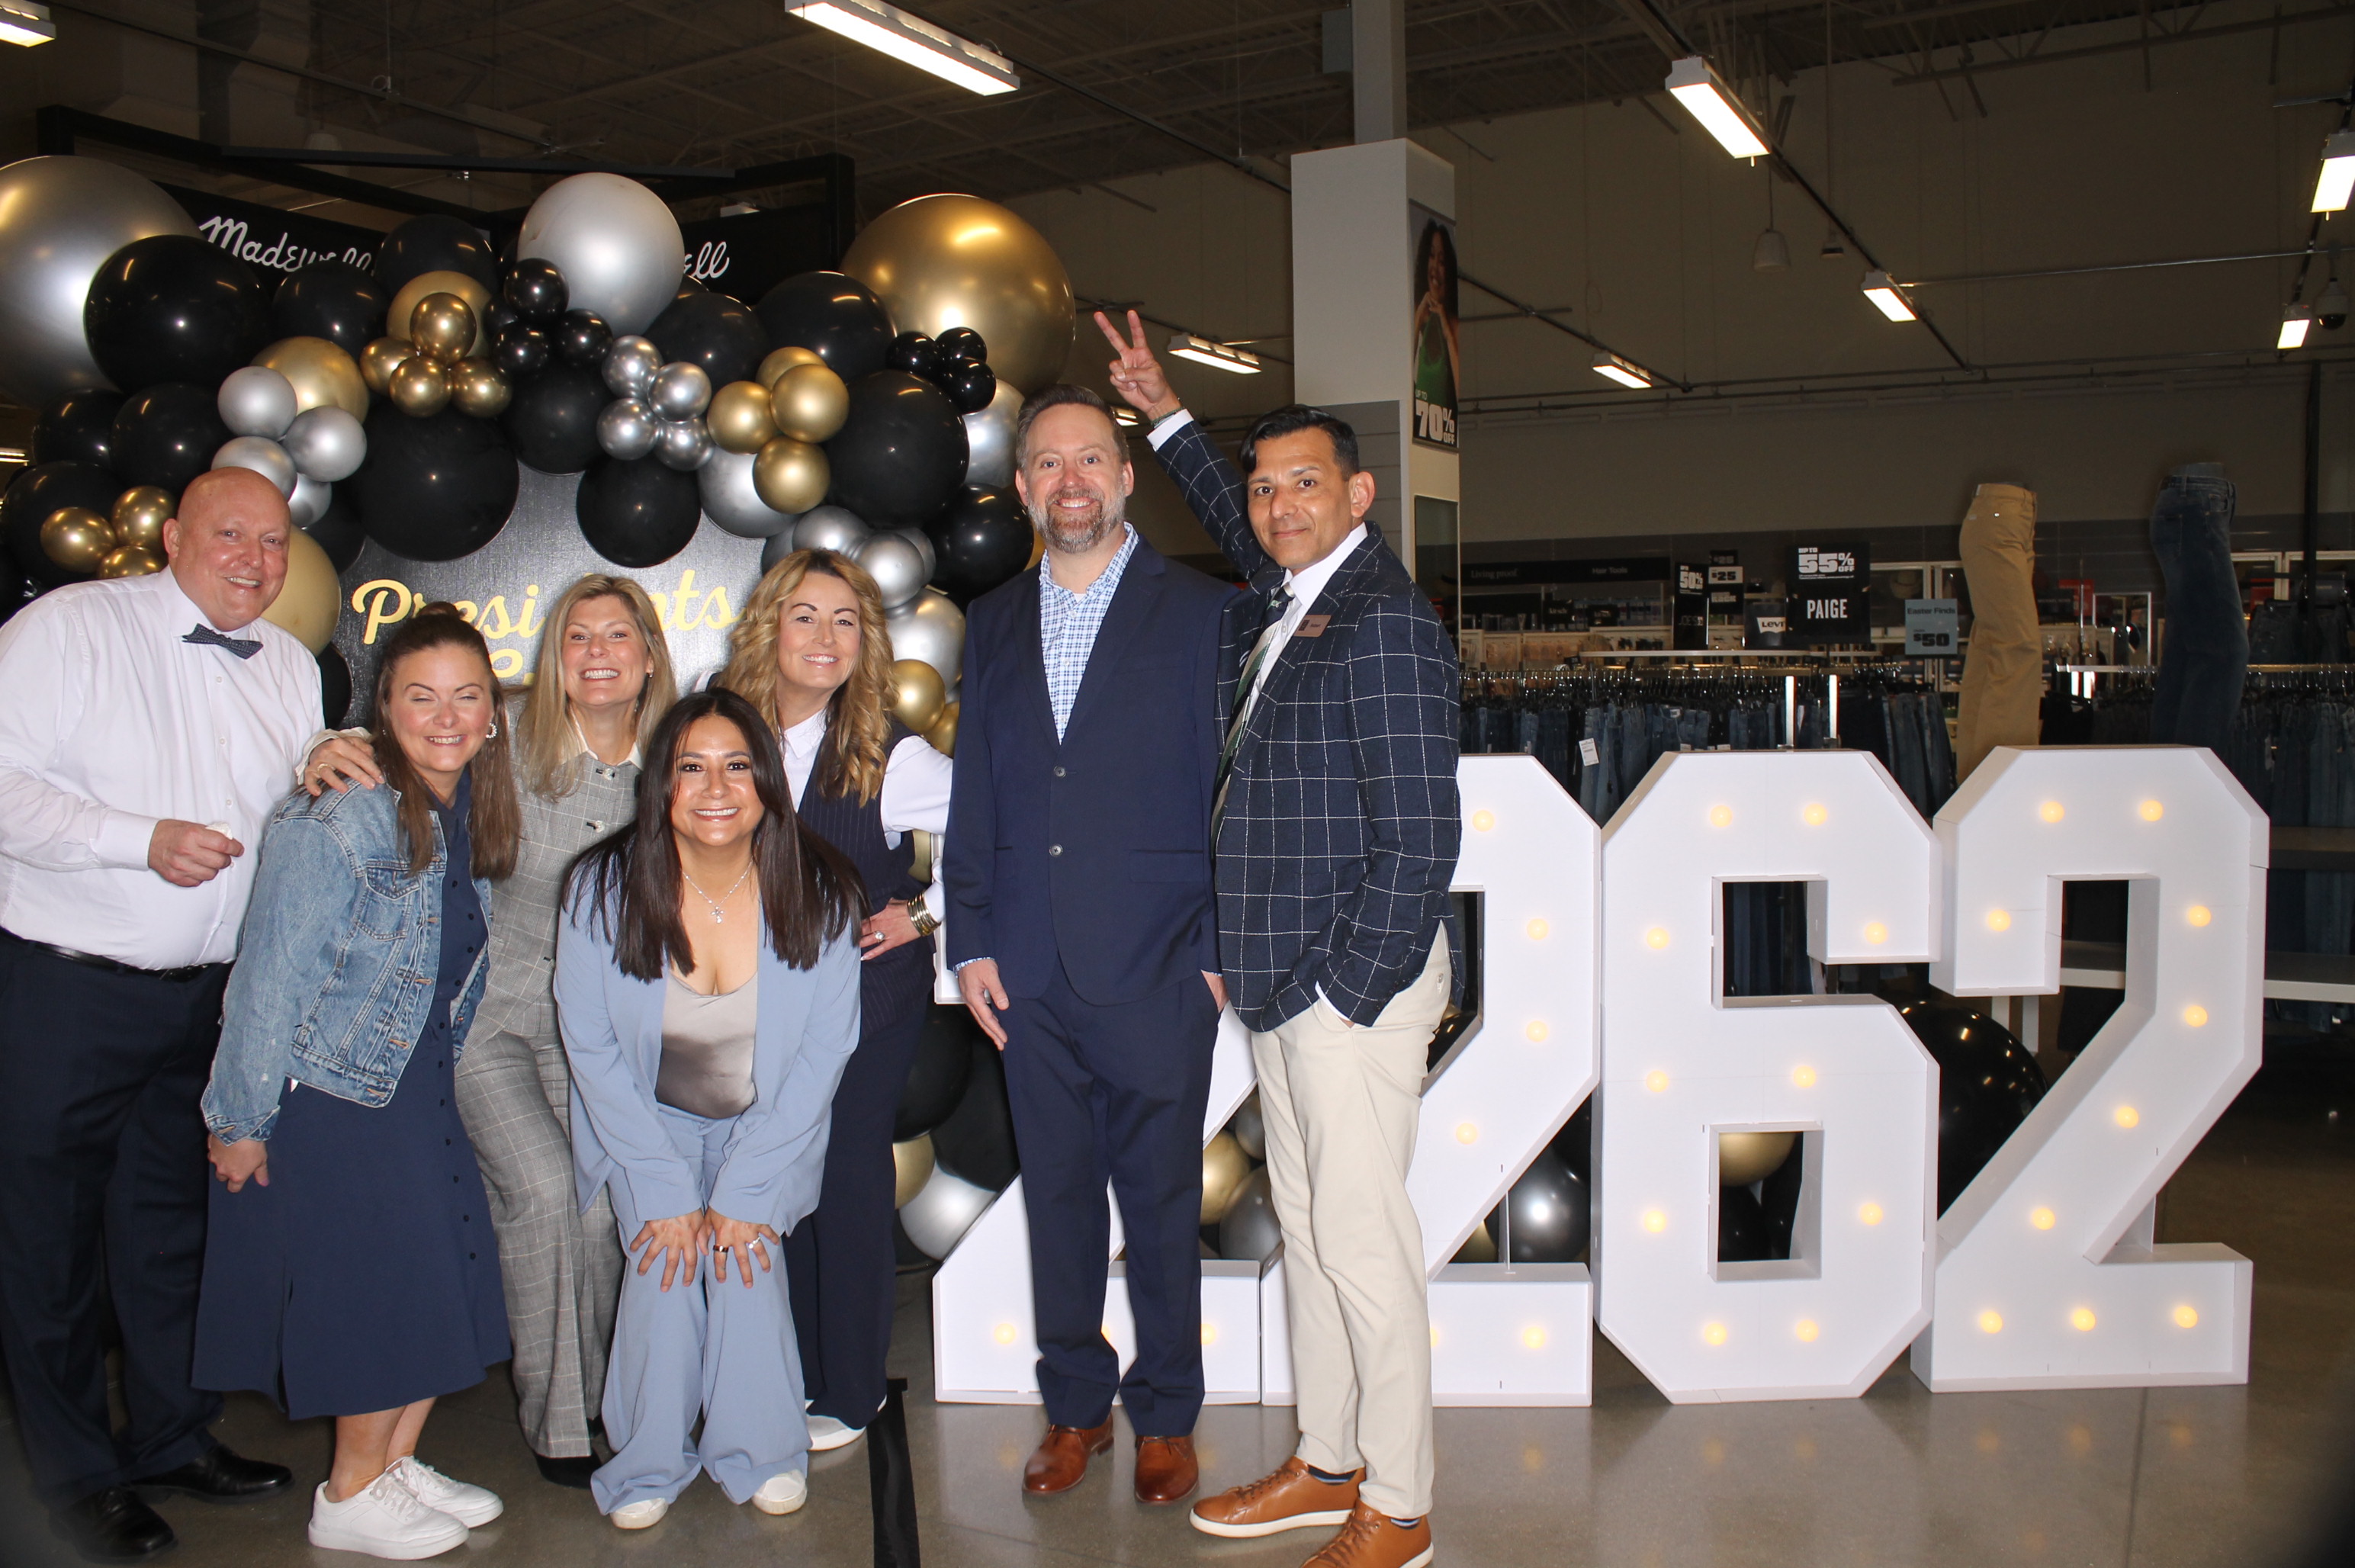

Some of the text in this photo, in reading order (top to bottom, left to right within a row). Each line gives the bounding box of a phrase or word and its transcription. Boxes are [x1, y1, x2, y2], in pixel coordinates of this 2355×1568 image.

[198, 215, 373, 273] Made
[1422, 390, 1428, 400] TO
[1415, 398, 1454, 442] 70%
[1443, 432, 1455, 445] OFF
[1798, 553, 1855, 574] 55%
[1470, 569, 1496, 580] Living
[1711, 571, 1736, 581] $25
[352, 569, 747, 644] Pesints
[1807, 599, 1848, 619] PAIGE
[1913, 633, 1950, 647] $50
